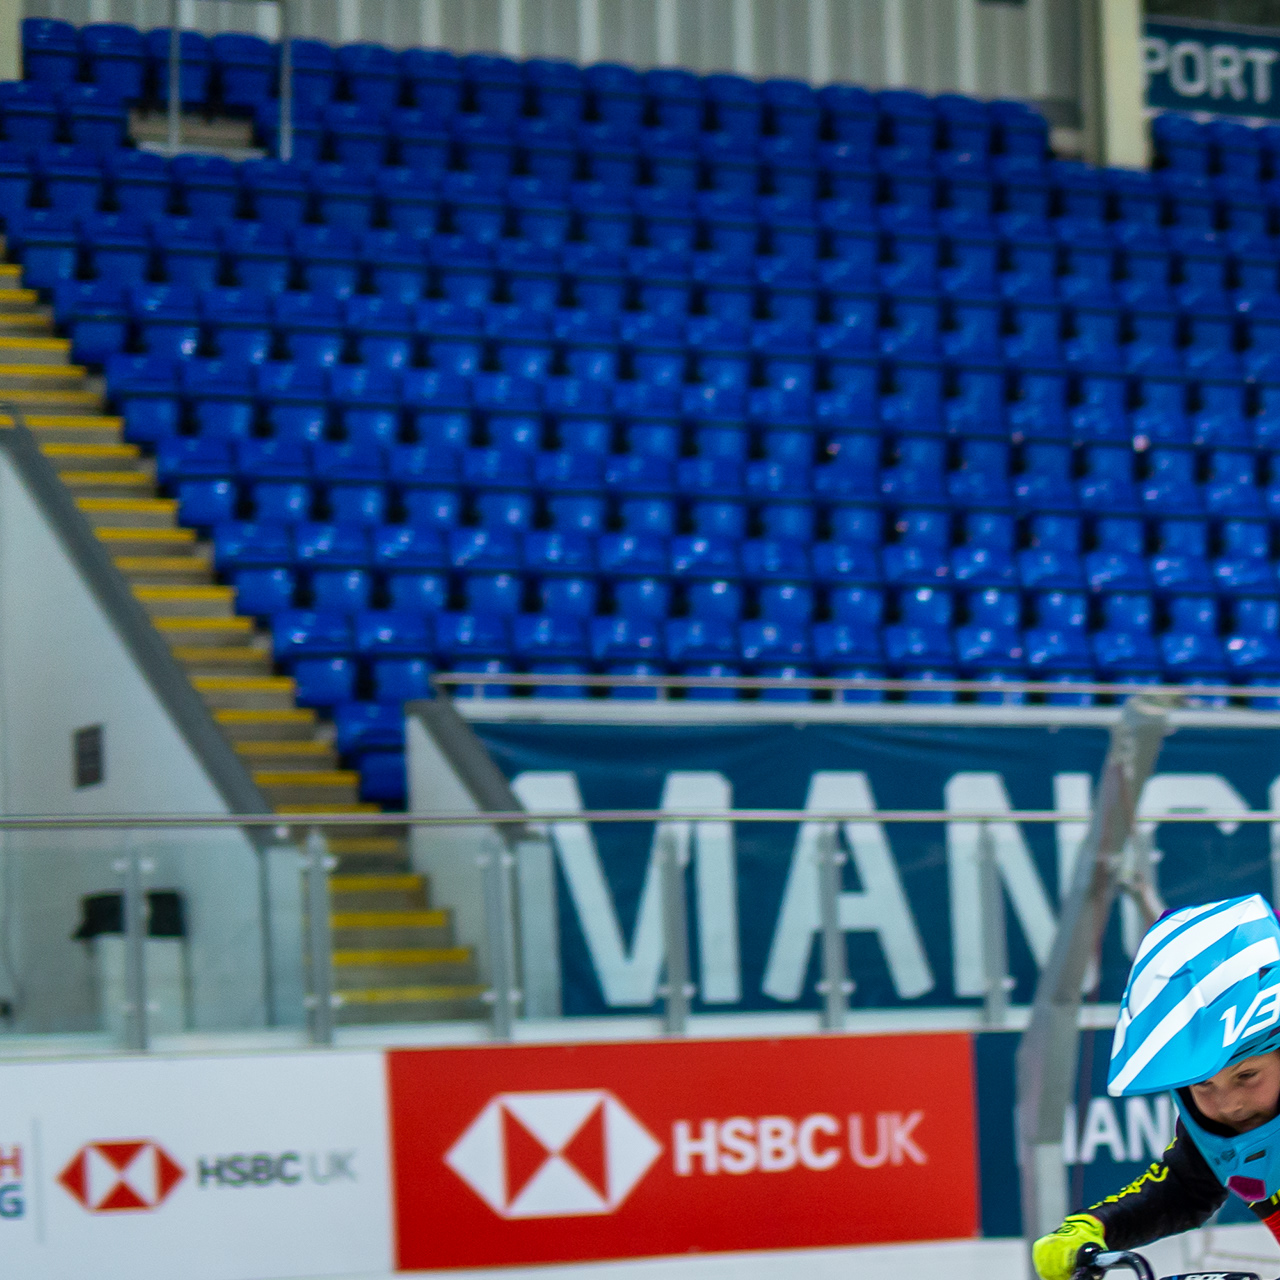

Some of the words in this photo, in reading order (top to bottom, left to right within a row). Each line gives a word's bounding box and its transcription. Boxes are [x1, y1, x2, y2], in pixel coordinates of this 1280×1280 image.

[197, 1152, 303, 1189] HSBC
[308, 1148, 358, 1184] UK
[672, 1114, 841, 1177] HSBC
[847, 1111, 929, 1168] UK
